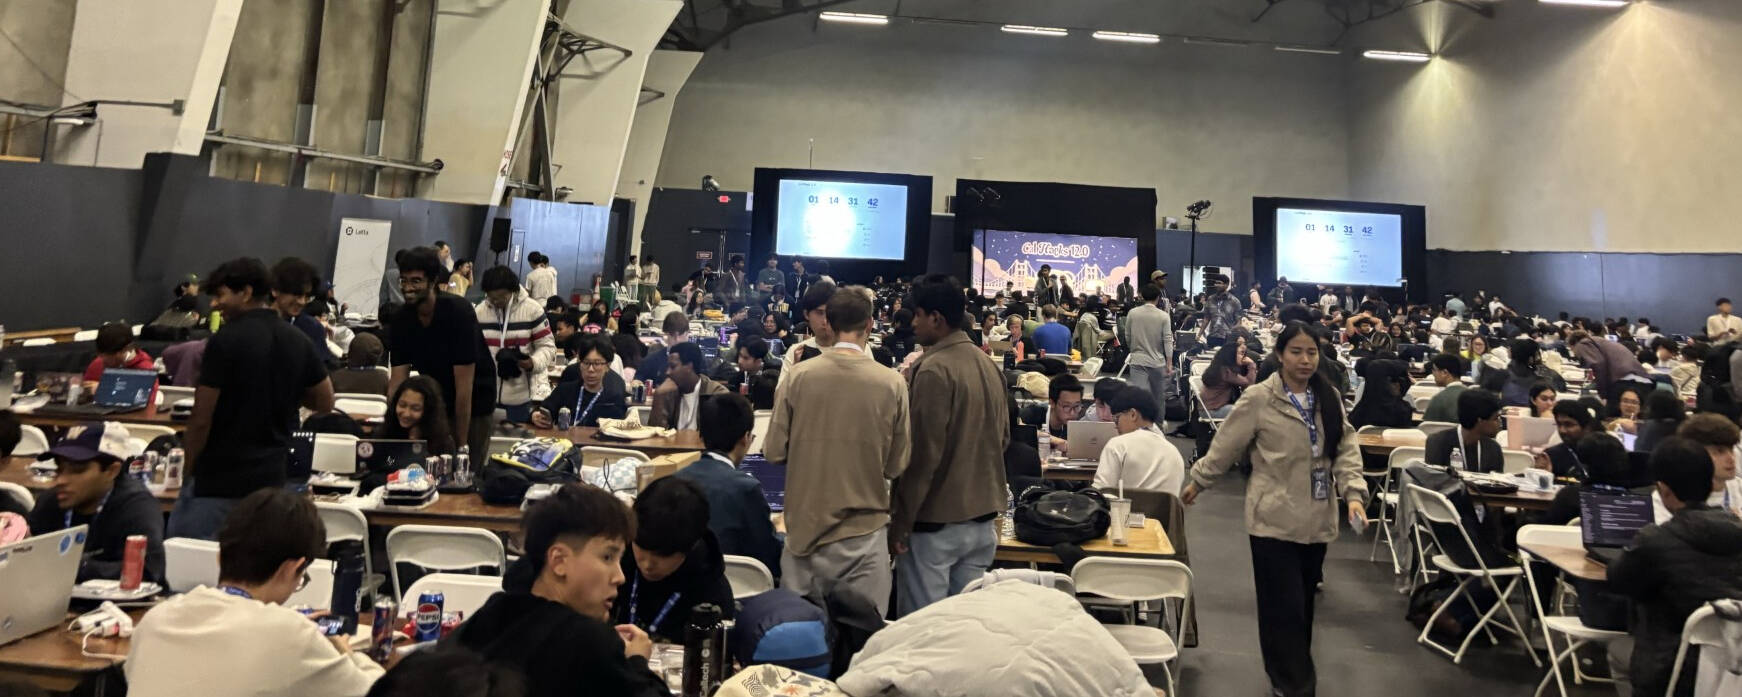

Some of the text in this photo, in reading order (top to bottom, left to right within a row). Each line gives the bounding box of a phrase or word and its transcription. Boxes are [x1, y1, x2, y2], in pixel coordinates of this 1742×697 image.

[808, 195, 818, 204] 01
[848, 198, 859, 206] 31
[867, 199, 879, 207] 42
[1023, 242, 1089, 257] Cal Hacks 12.0
[417, 613, 440, 621] PEPSI
